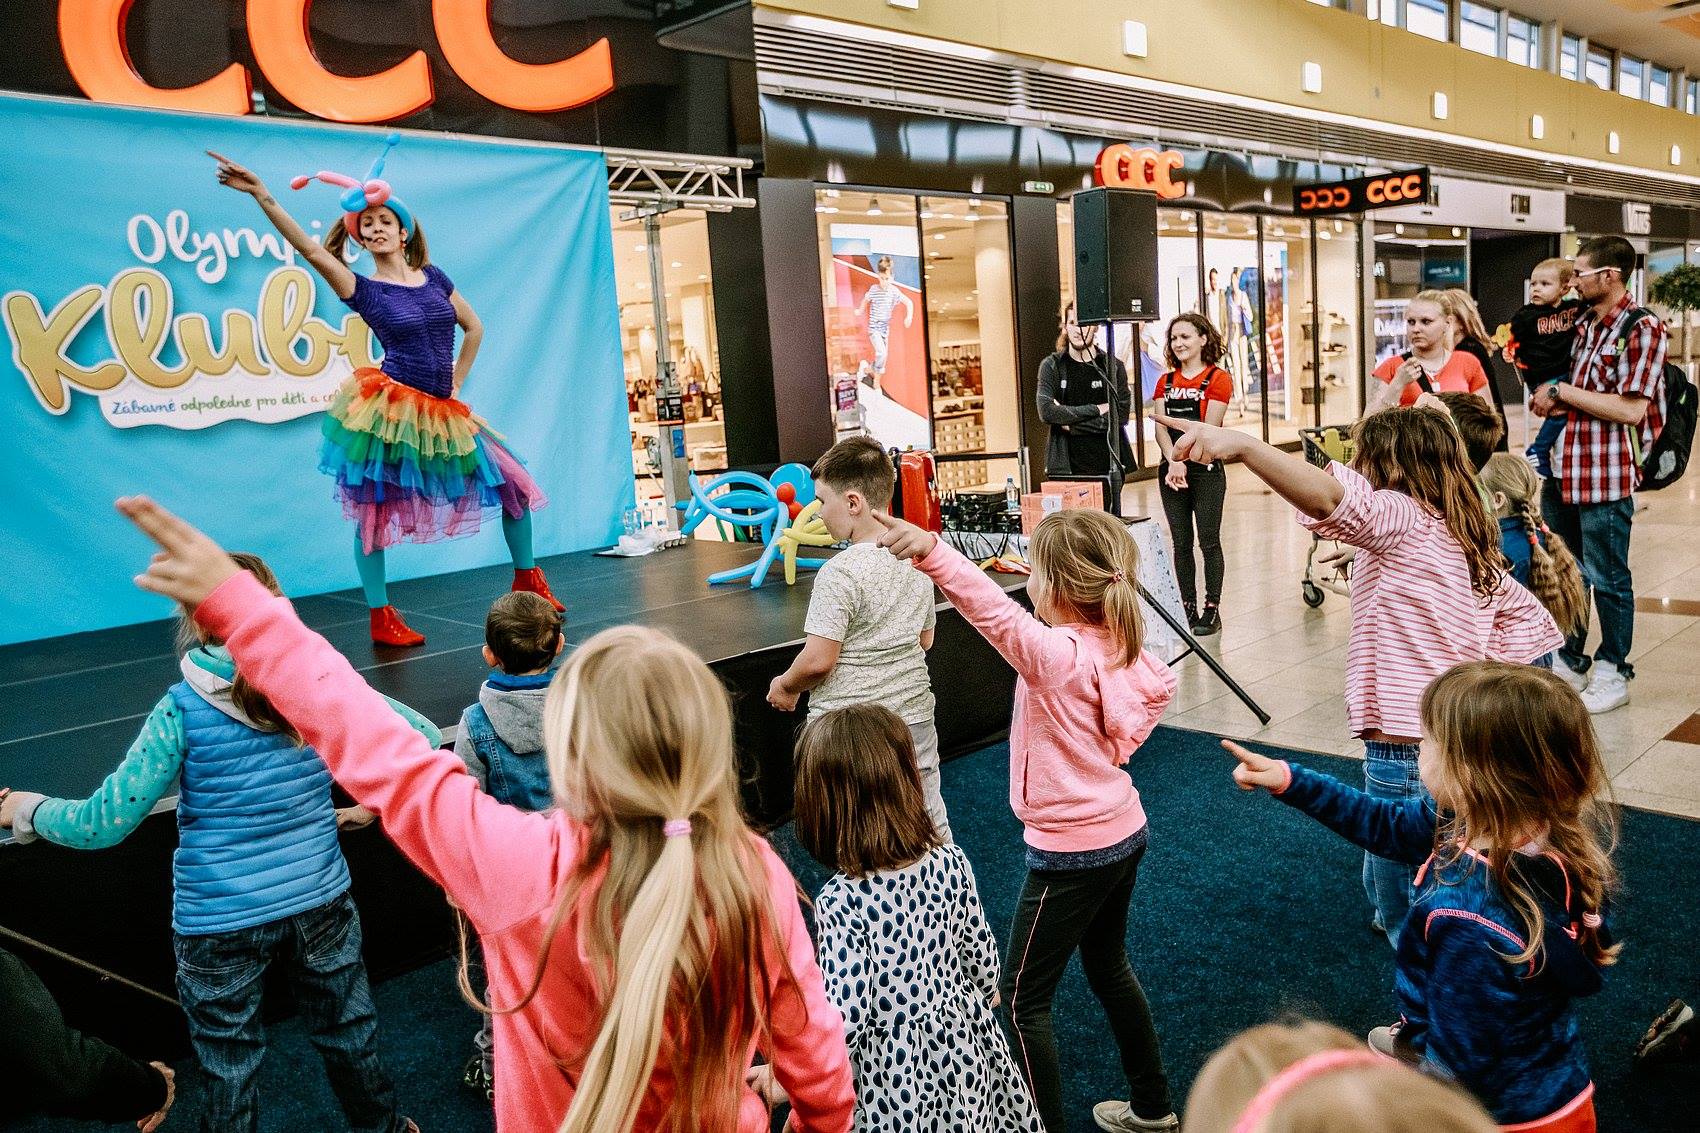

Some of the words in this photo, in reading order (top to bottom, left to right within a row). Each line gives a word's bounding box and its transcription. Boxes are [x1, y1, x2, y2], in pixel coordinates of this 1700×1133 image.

[1095, 143, 1185, 199] CCC
[1366, 174, 1422, 204] CCC
[180, 396, 252, 414] odpoledne
[257, 397, 277, 410] pro
[282, 391, 306, 405] děti
[310, 394, 320, 403] a
